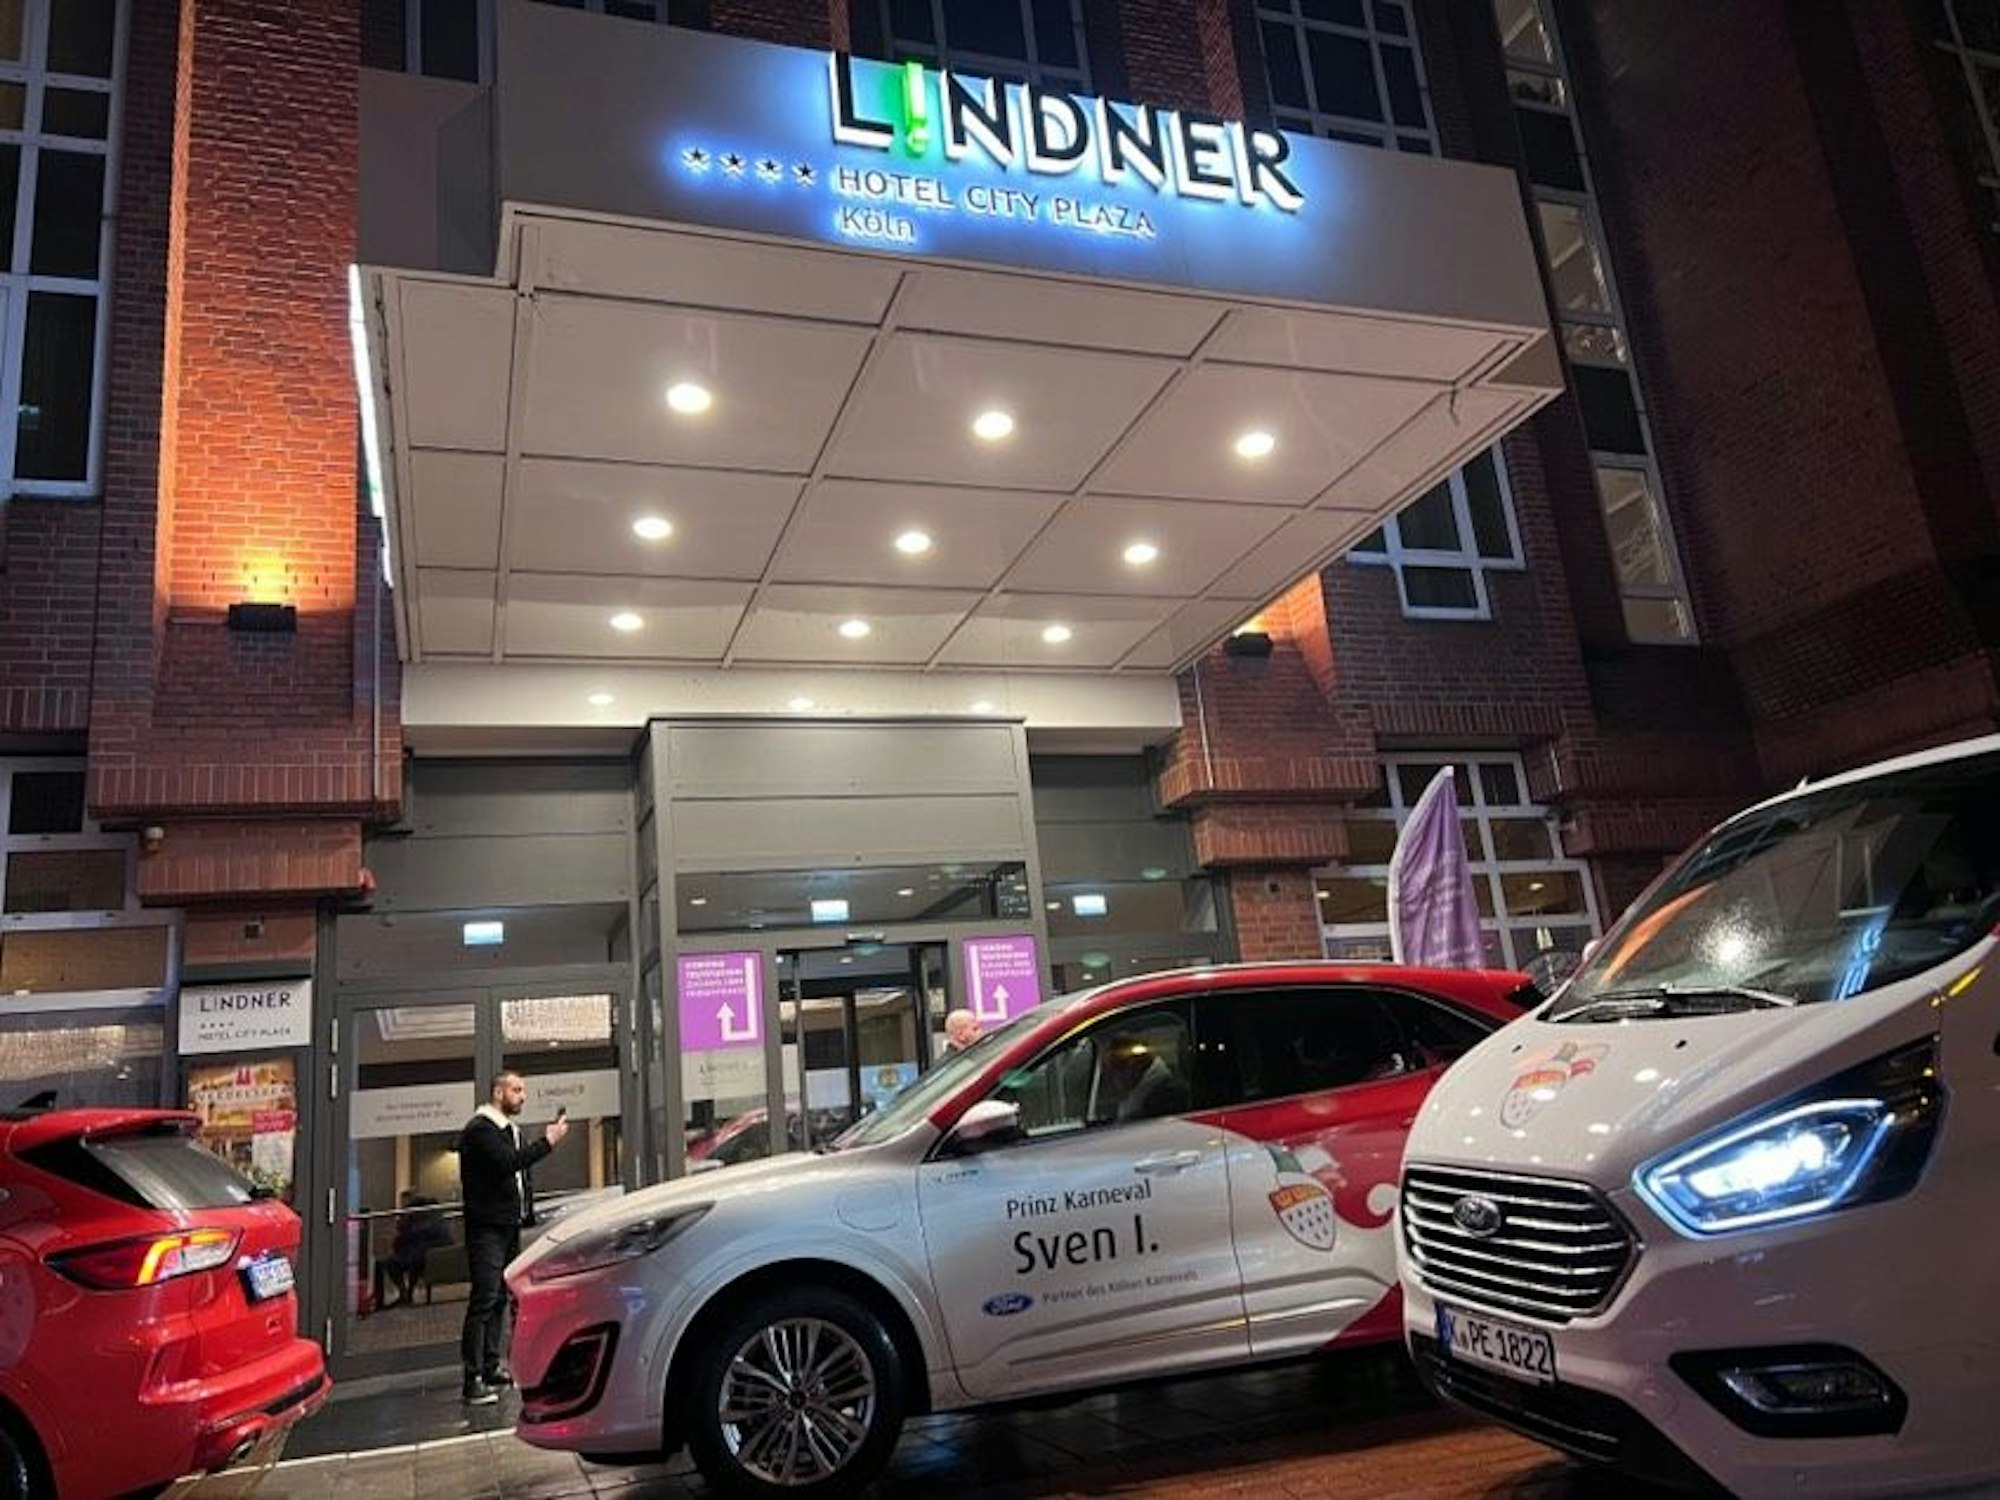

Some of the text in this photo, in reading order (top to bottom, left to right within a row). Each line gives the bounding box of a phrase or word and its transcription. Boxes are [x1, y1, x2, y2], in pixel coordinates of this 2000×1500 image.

[838, 166, 1156, 238] HOTEL CITY PLAZA
[841, 206, 916, 241] Köln
[1006, 1179, 1152, 1219] Prinz Karneval
[1013, 1214, 1159, 1275] Sven I.
[1496, 1329, 1550, 1375] 1822
